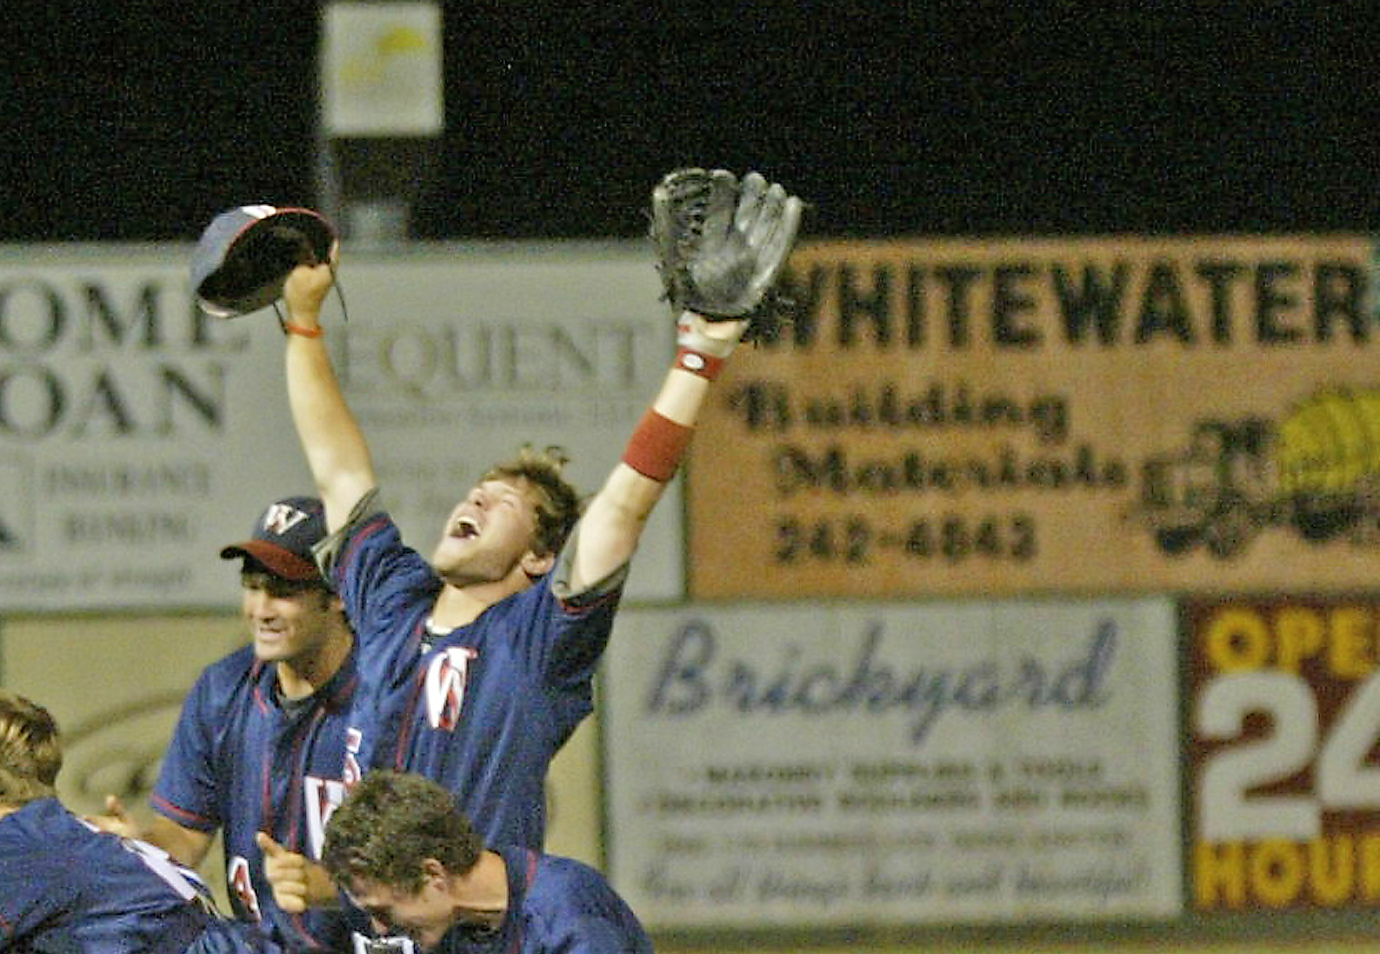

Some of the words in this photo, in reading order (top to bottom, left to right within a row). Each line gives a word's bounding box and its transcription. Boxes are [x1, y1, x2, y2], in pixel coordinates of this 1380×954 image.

[772, 443, 1128, 496] Materials
[262, 502, 308, 536] W
[644, 617, 1118, 746] Brickyard
